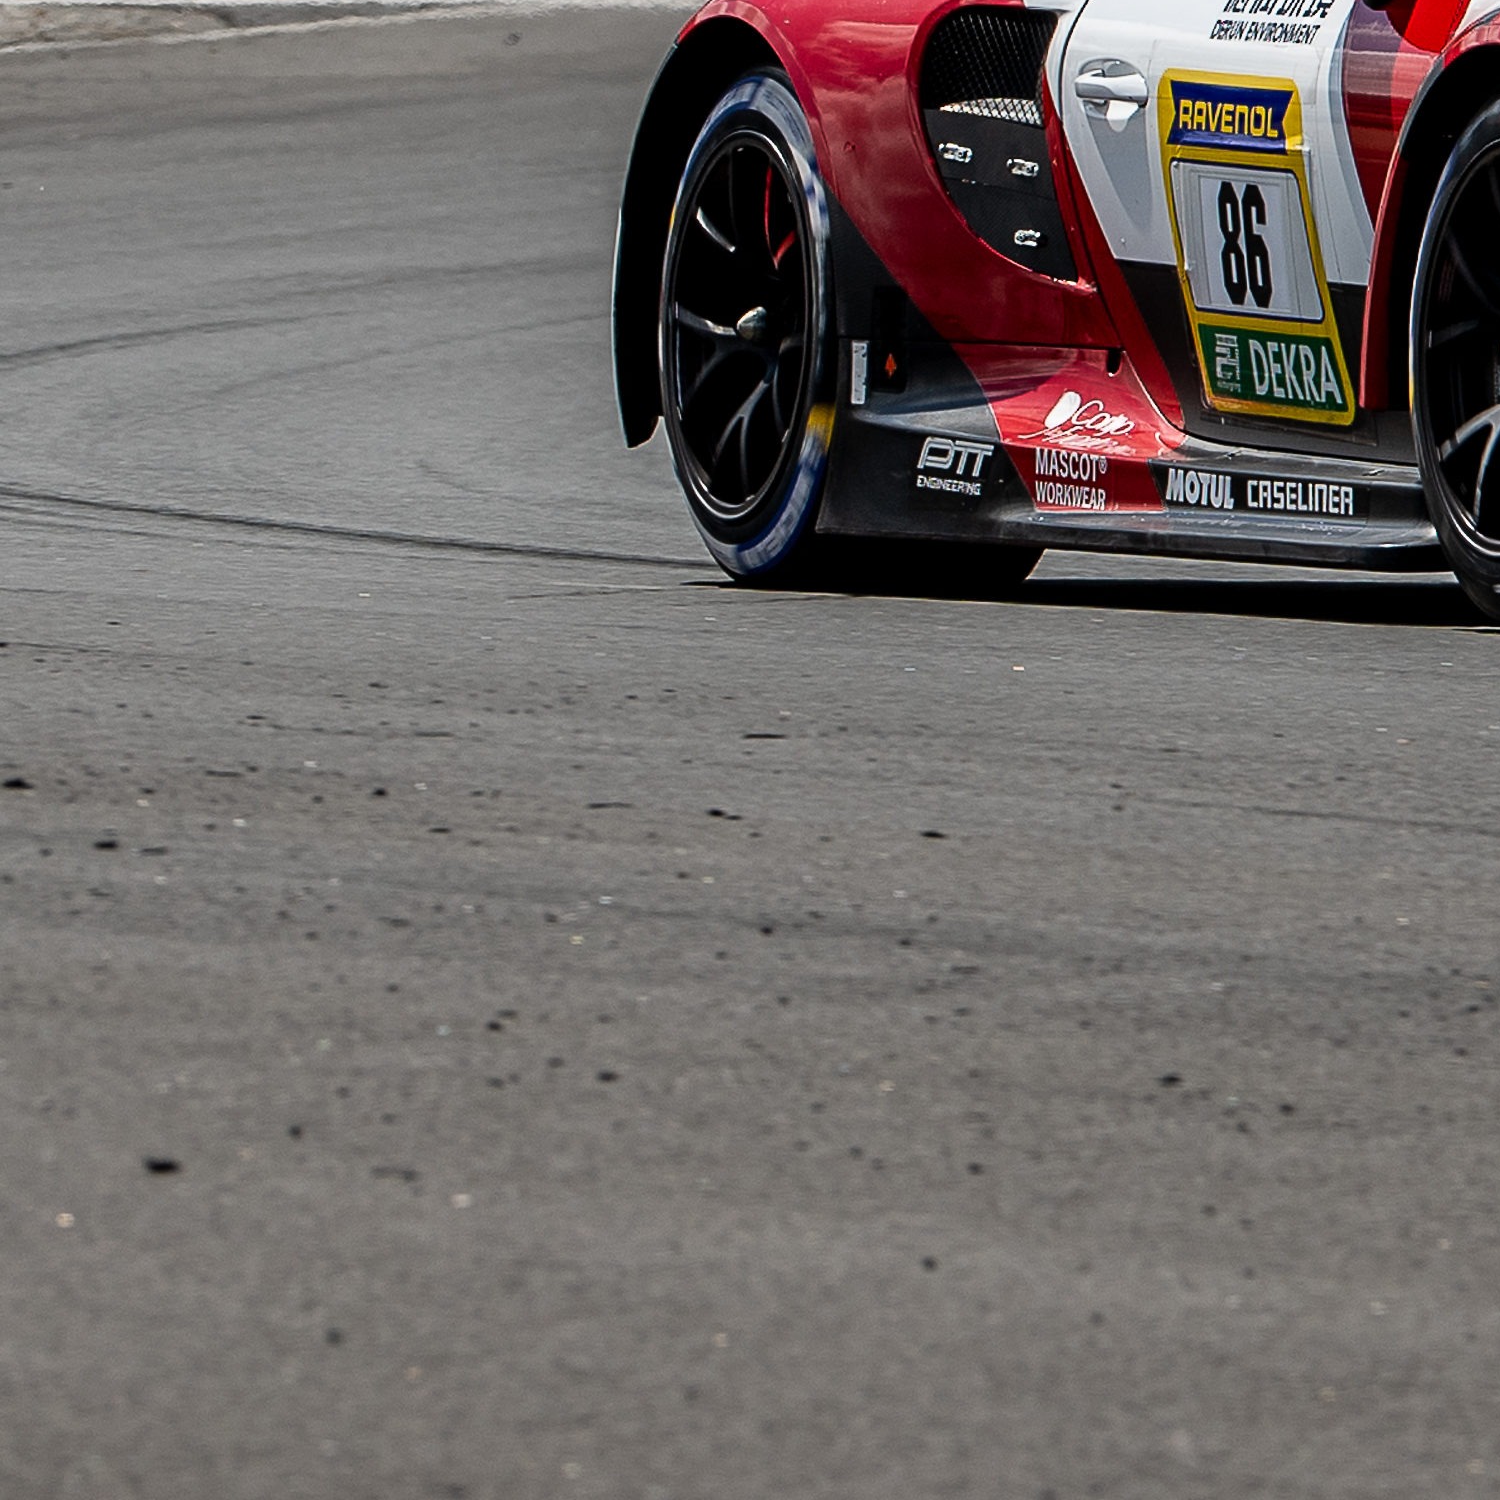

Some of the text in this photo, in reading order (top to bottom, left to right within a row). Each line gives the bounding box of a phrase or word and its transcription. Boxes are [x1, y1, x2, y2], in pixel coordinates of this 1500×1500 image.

[1209, 18, 1321, 45] DERUN ENVIRONMENT
[1179, 99, 1279, 138] RAVENOL
[1217, 181, 1273, 309] 86
[1248, 339, 1343, 405] DEKRA
[916, 475, 982, 496] ENGINEERING
[1035, 481, 1106, 510] WORKWEAR
[1165, 468, 1235, 510] MOTUL
[1247, 479, 1354, 516] CASELINER
